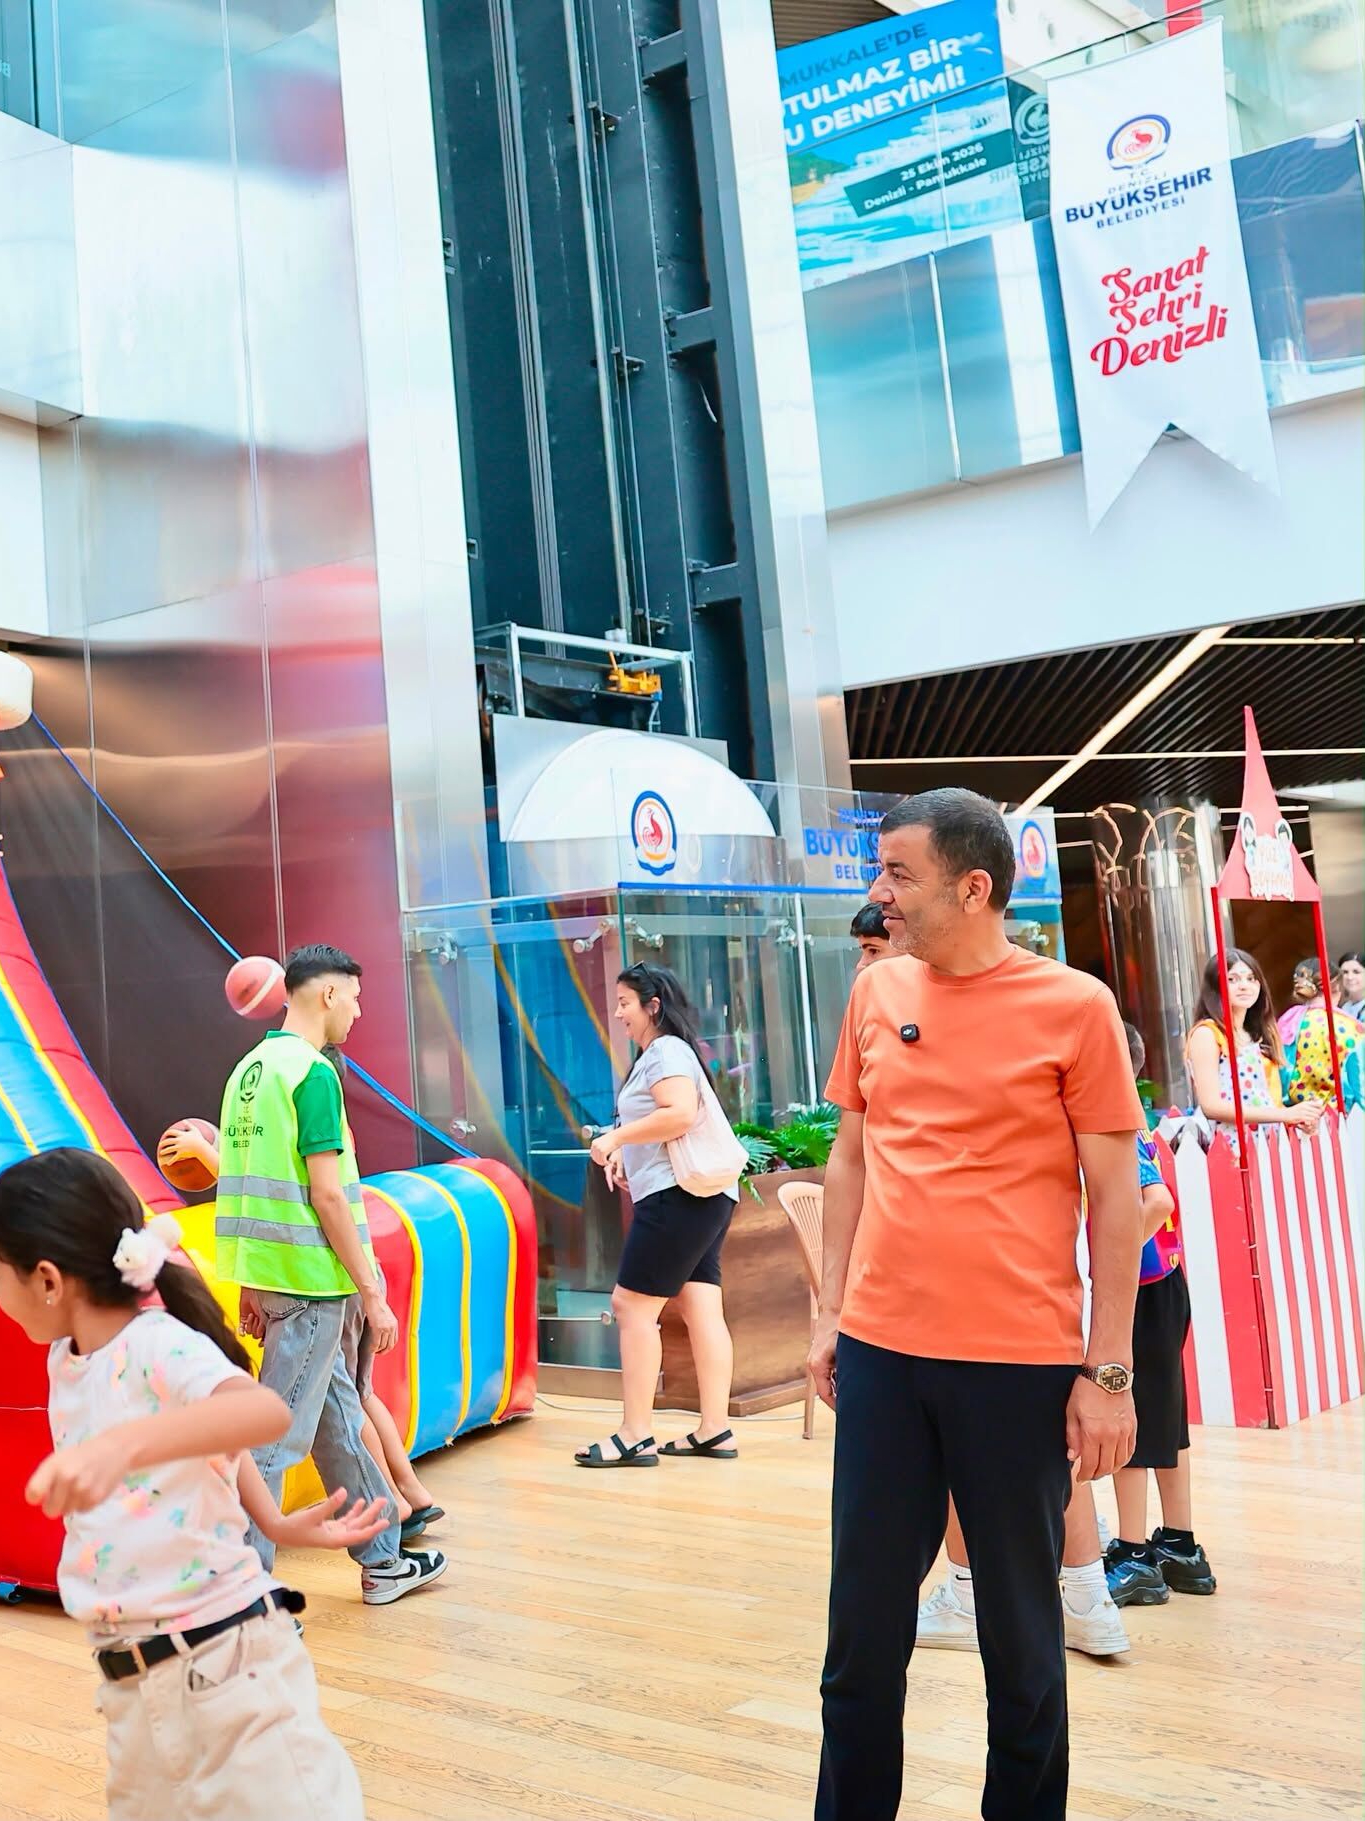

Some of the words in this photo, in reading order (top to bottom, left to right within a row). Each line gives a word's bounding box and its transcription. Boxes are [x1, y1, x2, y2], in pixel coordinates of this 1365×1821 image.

[778, 22, 928, 90] MUKKALE'DE
[782, 57, 904, 117] TULMAZ
[908, 38, 963, 72] BİR
[811, 64, 966, 138] DENEYİMİ!
[863, 185, 907, 209] Denizli
[915, 157, 987, 190] Pamukkale
[900, 167, 916, 181] 25
[917, 156, 951, 175] Ekim
[952, 142, 984, 161] 2026
[1101, 246, 1210, 304] Sanat
[1090, 304, 1229, 376] Denizli
